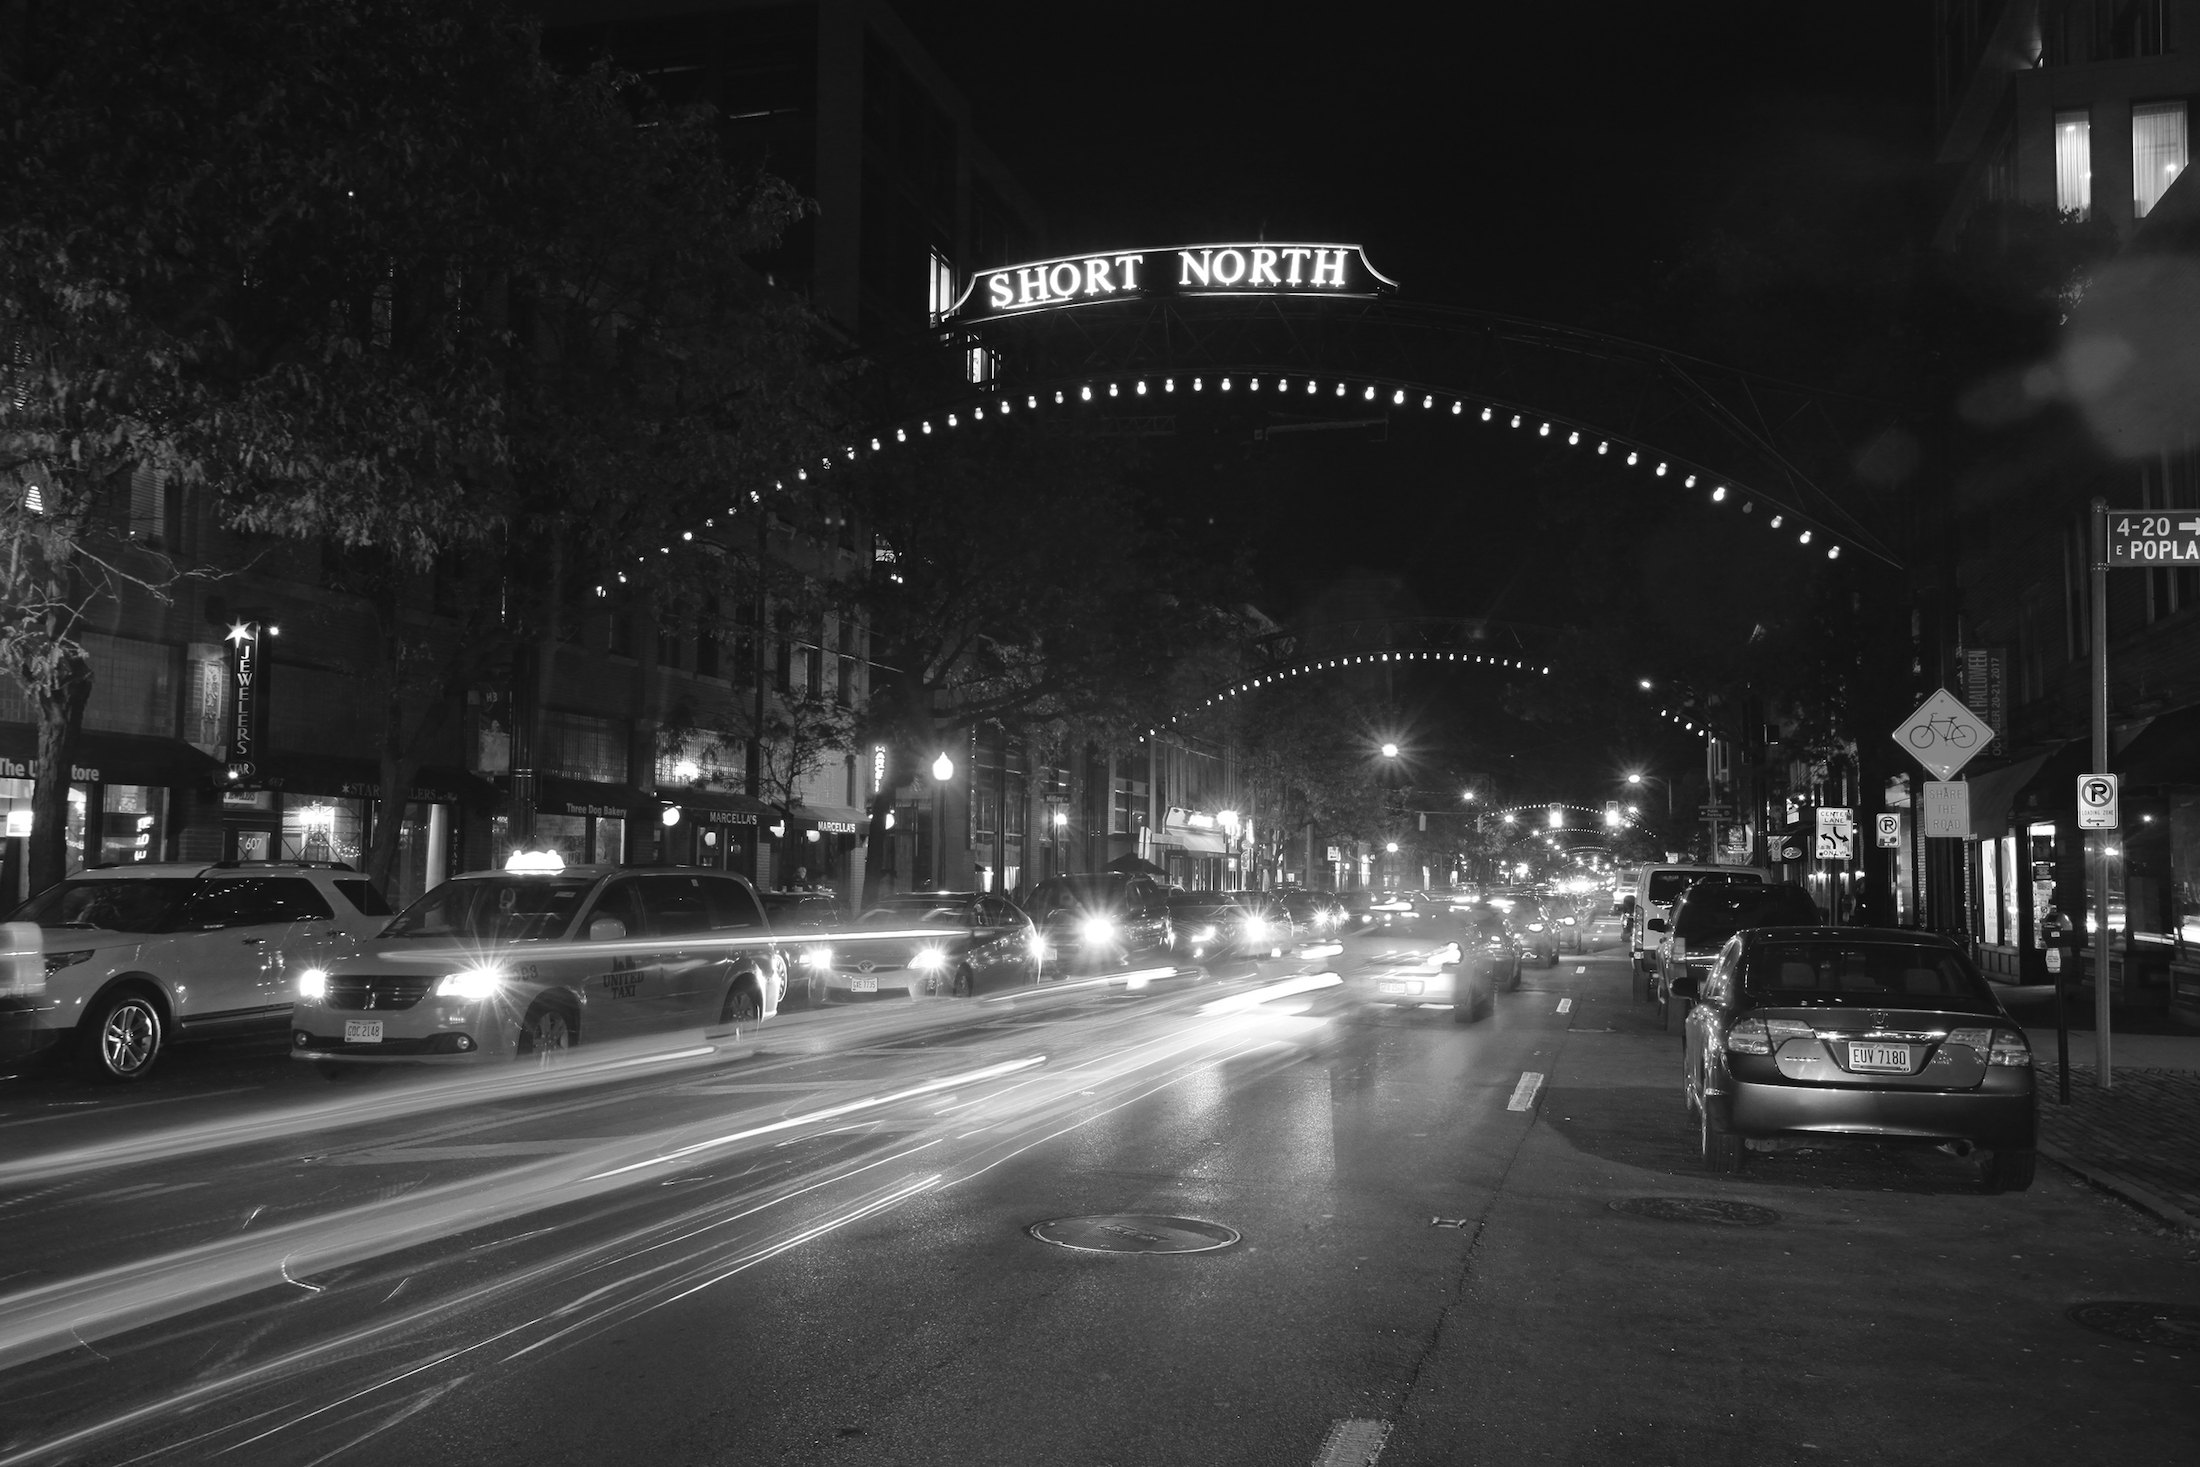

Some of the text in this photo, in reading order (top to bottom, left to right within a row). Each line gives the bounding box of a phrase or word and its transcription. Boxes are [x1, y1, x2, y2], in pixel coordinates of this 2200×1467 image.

[988, 248, 1348, 307] SHORT NORTH
[2116, 517, 2171, 537] 4-20
[2116, 540, 2199, 560] E POPLA
[1990, 657, 2000, 679] 2017
[1968, 650, 1988, 708] HALLOWEEN
[236, 645, 253, 754] JEWELERS
[0, 757, 25, 777] The
[71, 764, 99, 782] tore
[228, 763, 250, 776] STAR
[351, 782, 380, 797] STAR
[408, 787, 437, 800] LERS
[1929, 789, 1964, 800] SHARE
[566, 803, 627, 818] Three Dog Bakery
[1936, 804, 1956, 814] THE
[709, 811, 758, 825] MARCELLA'S
[1933, 820, 1961, 830] ROAD
[817, 821, 856, 833] MARCELLA'S
[245, 837, 262, 850] 607
[602, 971, 645, 988] UNITED
[611, 985, 637, 1000] TAXI
[362, 1025, 380, 1037] 2148
[1853, 1048, 1906, 1065] EUV 7180
